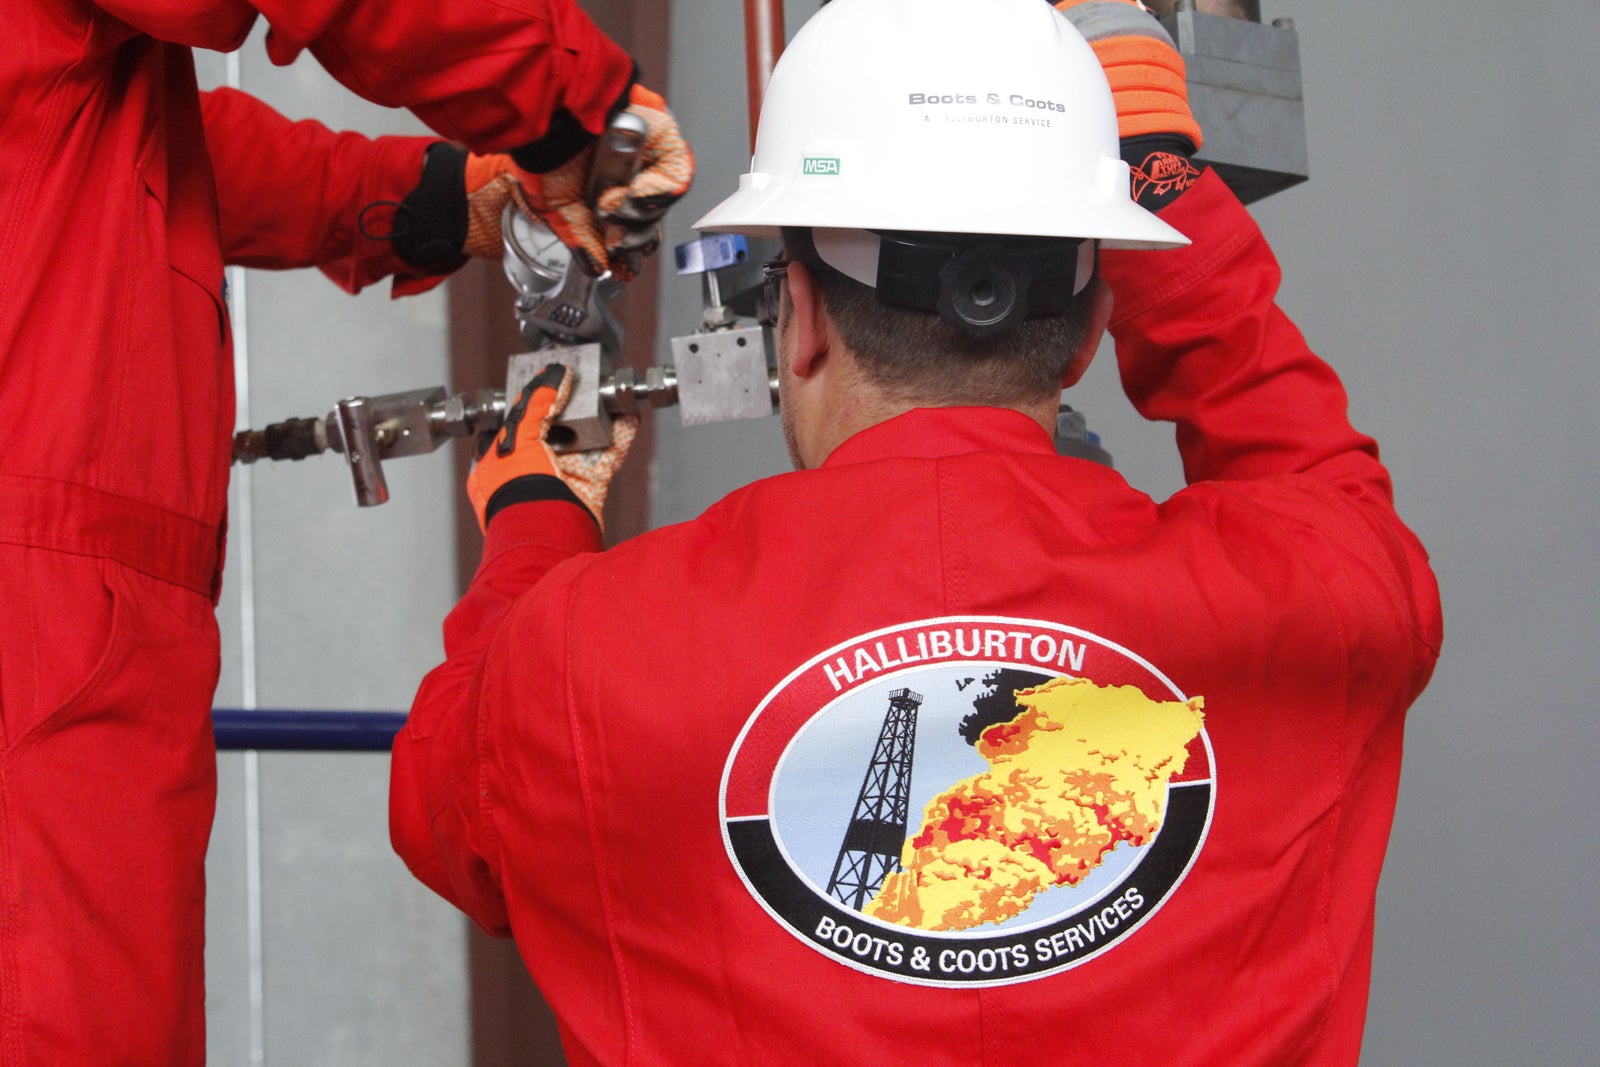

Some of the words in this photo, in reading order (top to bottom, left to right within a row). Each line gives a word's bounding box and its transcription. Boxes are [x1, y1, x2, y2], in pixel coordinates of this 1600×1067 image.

[908, 93, 977, 105] Boots
[986, 93, 1001, 104] &
[1009, 94, 1066, 113] Coots
[923, 114, 931, 122] A
[1012, 116, 1052, 128] SERVICE
[804, 159, 839, 173] MSA
[822, 629, 1087, 691] HALLIBURTON
[814, 916, 904, 967] BOOTS
[909, 947, 931, 972] &
[938, 948, 1029, 973] COOTS
[1035, 886, 1145, 962] SERVICES
